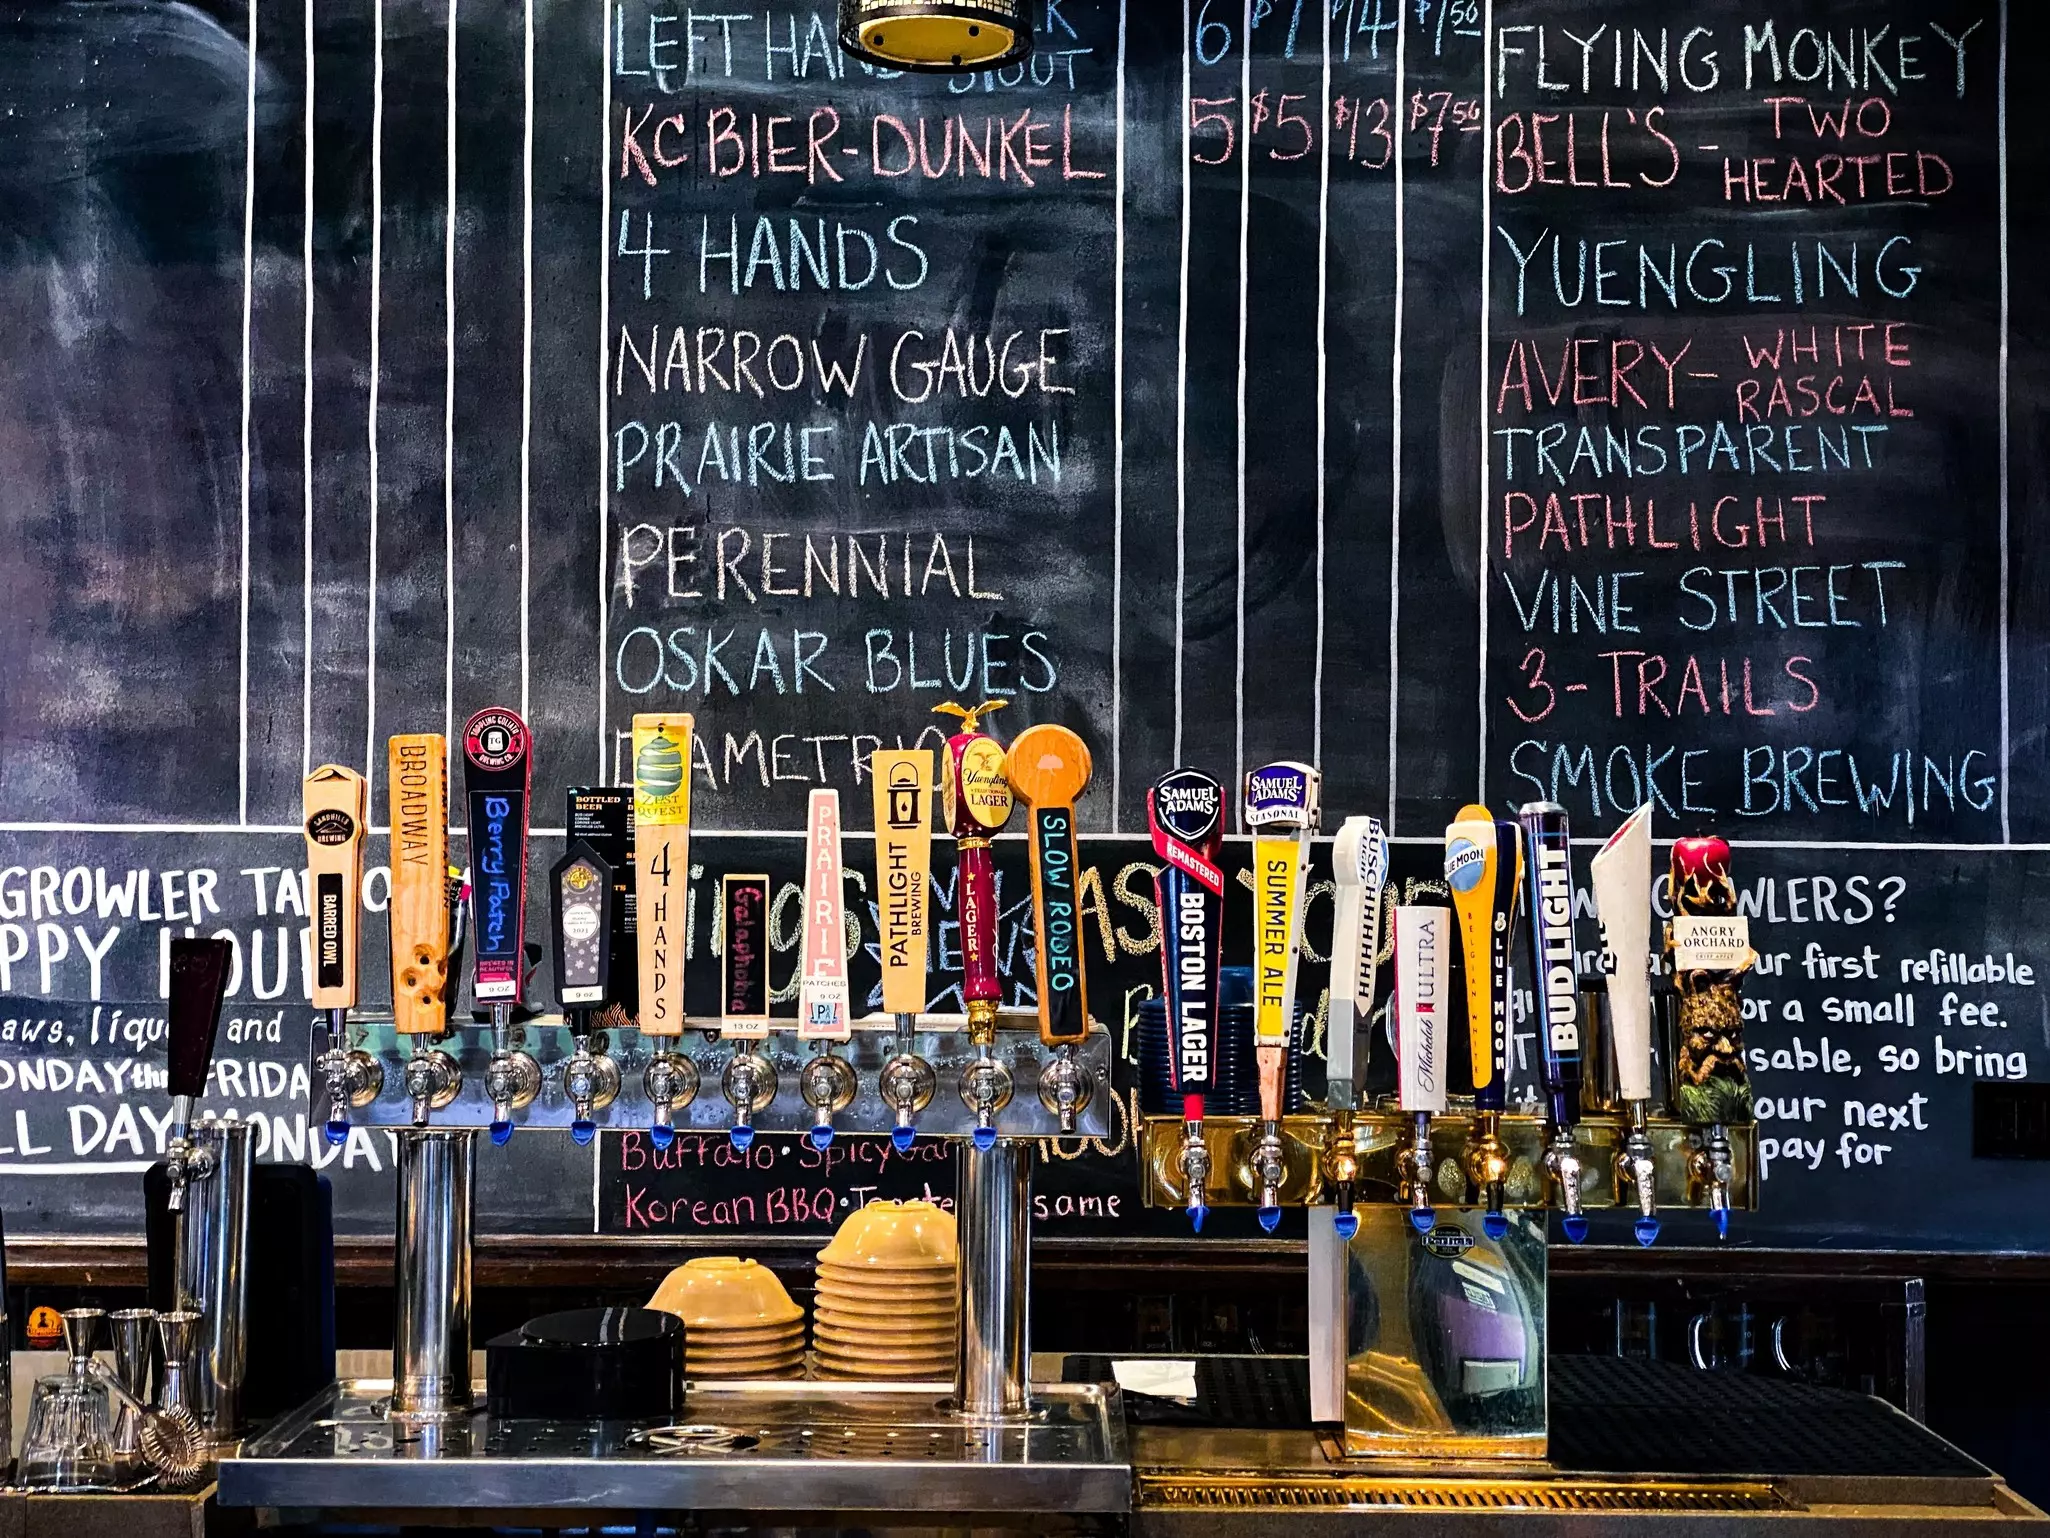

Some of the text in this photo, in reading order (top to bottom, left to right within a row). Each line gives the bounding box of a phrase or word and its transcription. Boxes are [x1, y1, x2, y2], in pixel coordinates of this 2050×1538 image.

[616, 13, 752, 79] LEFT
[1196, 0, 1232, 66] 6
[1499, 18, 1984, 99] FLYING MONKEY
[620, 103, 688, 187] KC
[706, 104, 1106, 188] BIER-DUNKEL
[1190, 97, 1236, 165] 5
[1251, 87, 1314, 161] $5
[1333, 95, 1393, 169] $13
[1496, 105, 1681, 194] BELL'S
[1763, 96, 1893, 140] TWO
[1723, 149, 1955, 205] HEARTED
[617, 208, 929, 300] 4 HANDS
[1497, 225, 1923, 317] YUENGLING
[617, 324, 1077, 401] NARROW GAUGE
[1743, 321, 1913, 370] WHITE
[1735, 374, 1916, 423] RASCAL
[613, 419, 1061, 497] PRAIRIE ARTISAN
[1493, 420, 1890, 487] TRANSPARENT
[1503, 491, 1828, 559] PATHLIGHT
[619, 522, 1005, 611] PERENNIAL
[1503, 560, 1907, 635] VINE STREET
[615, 625, 1060, 697] OSKAR BLUES
[490, 737, 501, 745] TG
[399, 745, 429, 867] BROADWAY
[642, 794, 680, 806] ZEST
[962, 767, 1008, 788] Yuengling
[970, 794, 1009, 807] LAGER
[1159, 786, 1219, 803] SAMUEL
[1165, 800, 1214, 815] ADAMS
[1251, 775, 1303, 791] SAMUEL
[1253, 788, 1299, 803] ADAMS
[1507, 739, 1996, 829] SMOKE BREWING
[317, 833, 346, 843] BREWING
[481, 795, 510, 874] Berry
[637, 805, 684, 818] QUEST
[1250, 809, 1299, 822] SEASONAL
[813, 804, 836, 977] PRAIRIE
[1166, 841, 1220, 887] REMASTERED
[1358, 834, 1368, 883] LIGHT
[1456, 848, 1484, 868] MOON
[0, 865, 220, 925] GROWLER
[486, 881, 511, 952] Patch
[888, 842, 909, 968] PATHLIGHT
[910, 871, 922, 937] BREWING
[965, 882, 978, 960] LAGER
[1043, 814, 1074, 992] SLOW RODEO
[322, 894, 338, 968] BARRED OWL
[650, 842, 671, 1020] 4 HANDS
[1263, 859, 1287, 1009] SUMMER ALE
[1539, 844, 1579, 1051] BUD LIGHT
[1683, 937, 1745, 948] ORCHARD
[1691, 926, 1736, 937] ANGRY
[1801, 941, 1881, 980] first
[1901, 947, 2036, 986] refillable
[1179, 892, 1206, 1083] BOSTON LAGER
[1418, 919, 1435, 1093] Michelob ULTRA
[1467, 911, 1480, 1075] BELGIAN WHITE
[1494, 911, 1507, 1071] BLUE MOON
[1782, 997, 1804, 1022] a
[1821, 993, 1915, 1027] small
[1939, 991, 2008, 1028] fee.
[227, 1010, 284, 1044] and
[1878, 1044, 1920, 1073] so
[1935, 1034, 2028, 1080] bring
[66, 1102, 174, 1156] DAY
[1843, 1091, 1929, 1132] next
[622, 1130, 775, 1171] Buffalo
[799, 1132, 892, 1177] Spicy
[1758, 1131, 1893, 1181] pay for
[625, 1183, 755, 1229] Korean
[766, 1186, 836, 1224] BBQ
